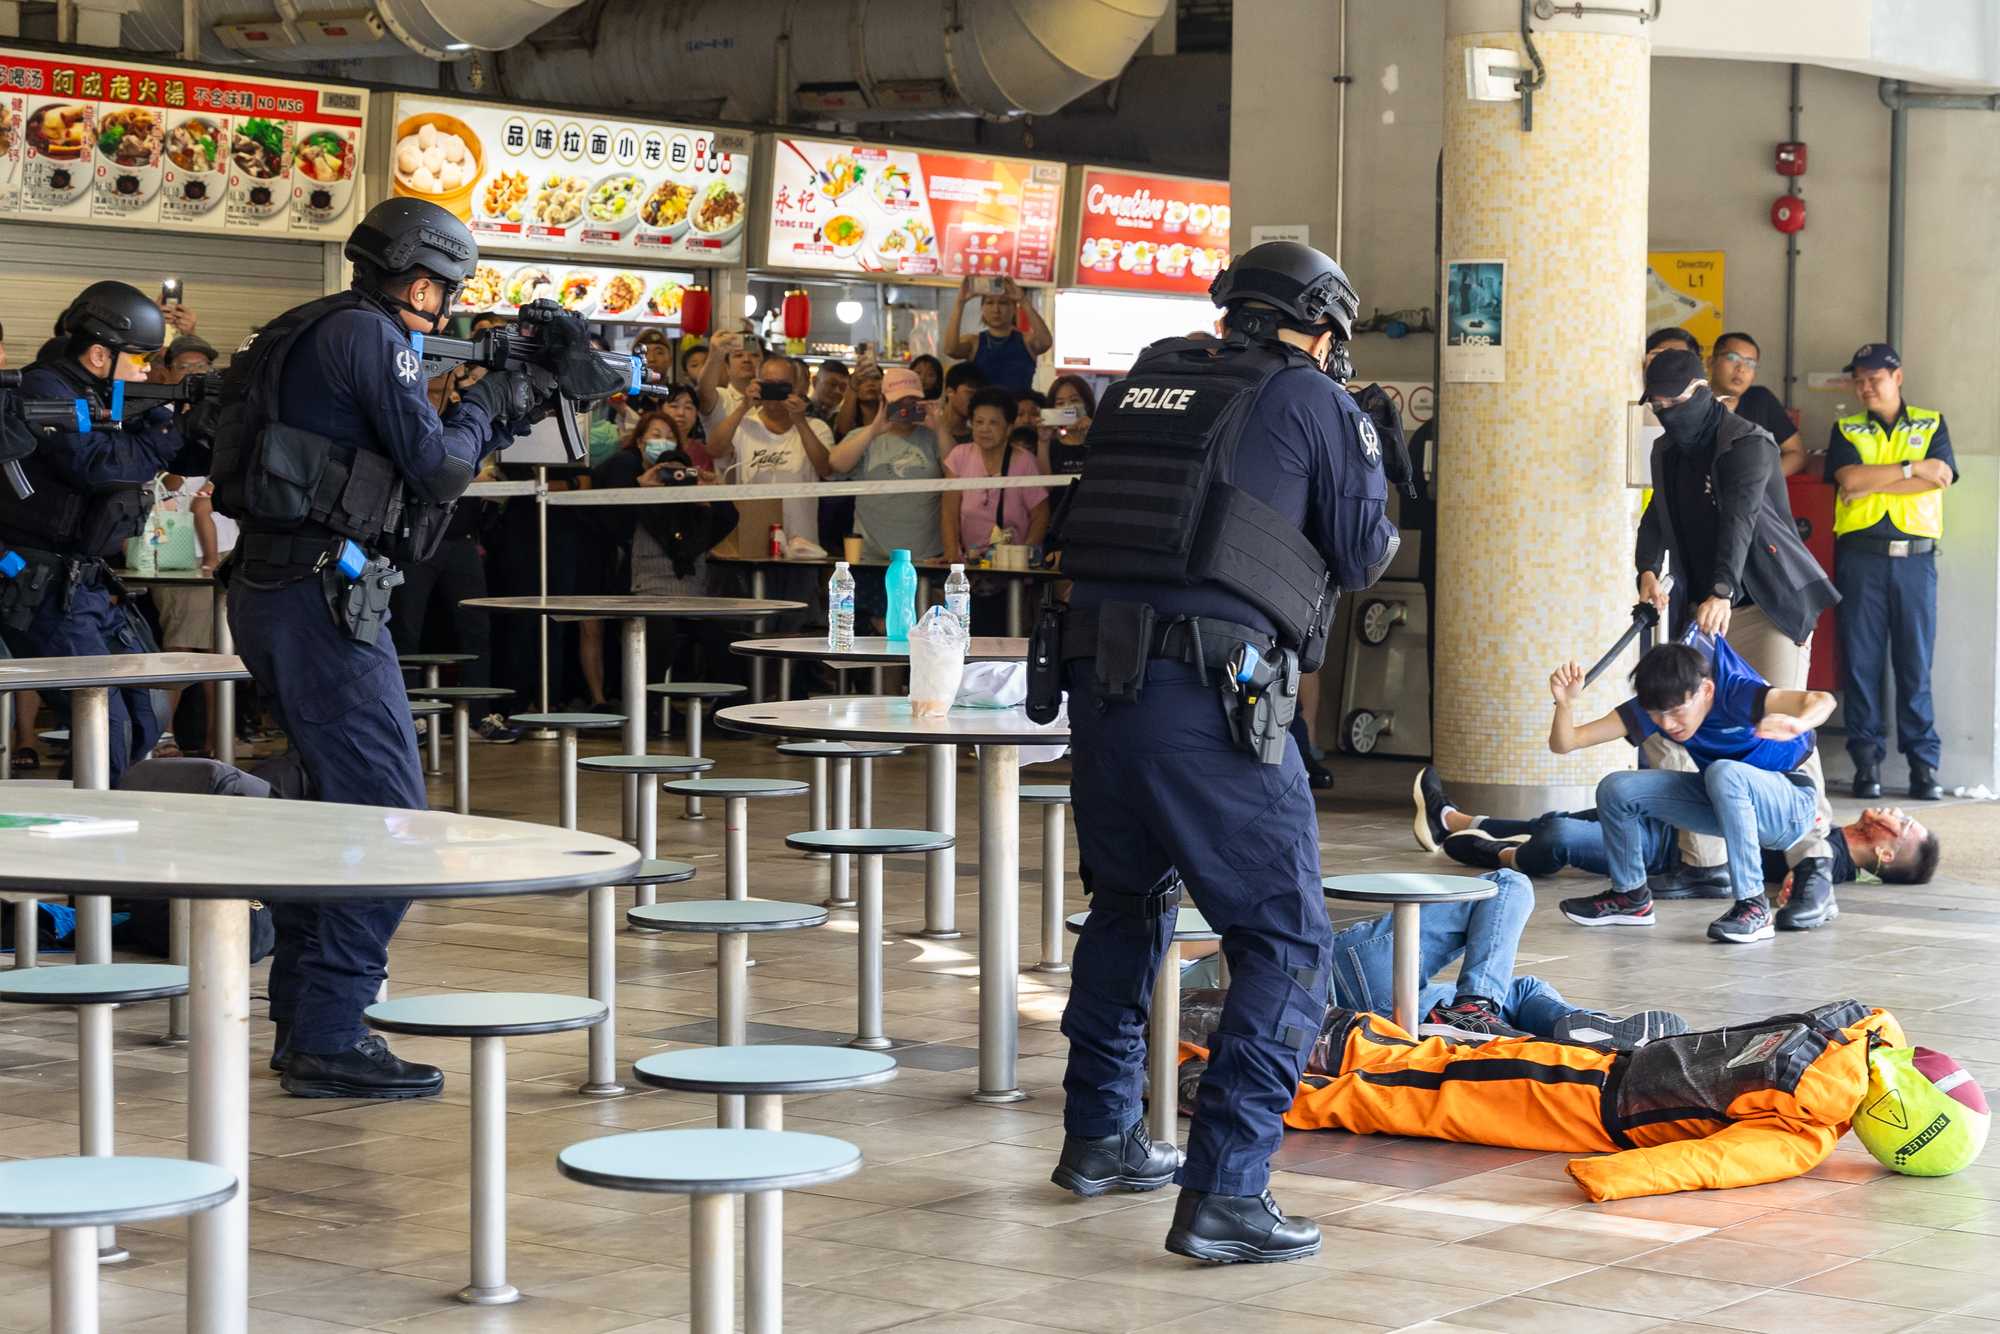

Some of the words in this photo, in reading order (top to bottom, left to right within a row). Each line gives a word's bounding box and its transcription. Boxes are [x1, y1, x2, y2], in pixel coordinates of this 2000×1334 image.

[257, 97, 275, 110] NO
[277, 98, 304, 113] MSG
[506, 124, 687, 164] 品味拉面小笼包
[776, 184, 816, 214] 永记
[1688, 273, 1704, 288] L1
[1119, 387, 1197, 411] POLICE
[1921, 1116, 1947, 1142] RUTH
[1904, 1138, 1924, 1154] LEE
